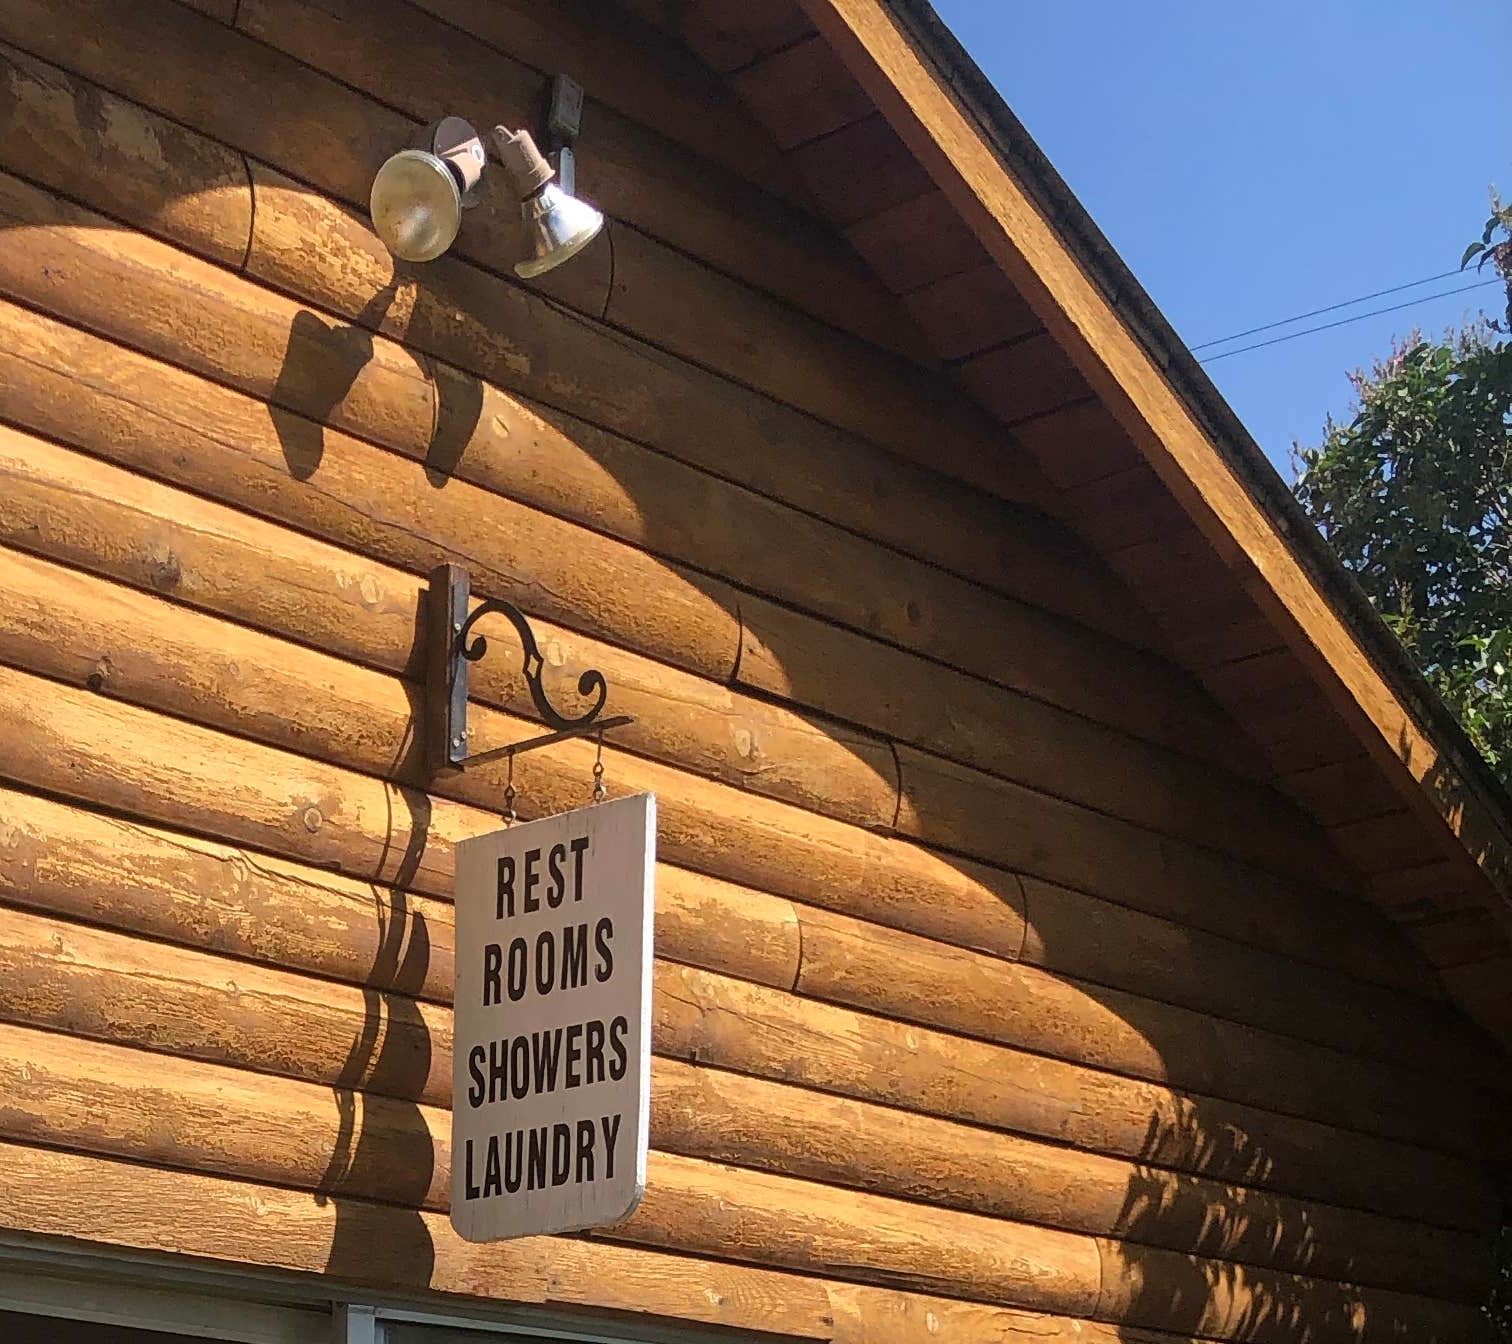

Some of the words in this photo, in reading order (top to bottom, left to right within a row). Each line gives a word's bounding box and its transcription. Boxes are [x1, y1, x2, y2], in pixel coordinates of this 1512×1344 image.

[496, 837, 589, 920] REST
[483, 917, 614, 1006] ROOMS
[468, 1016, 628, 1109] SHOWERS
[465, 1114, 621, 1200] LAUNDRY
